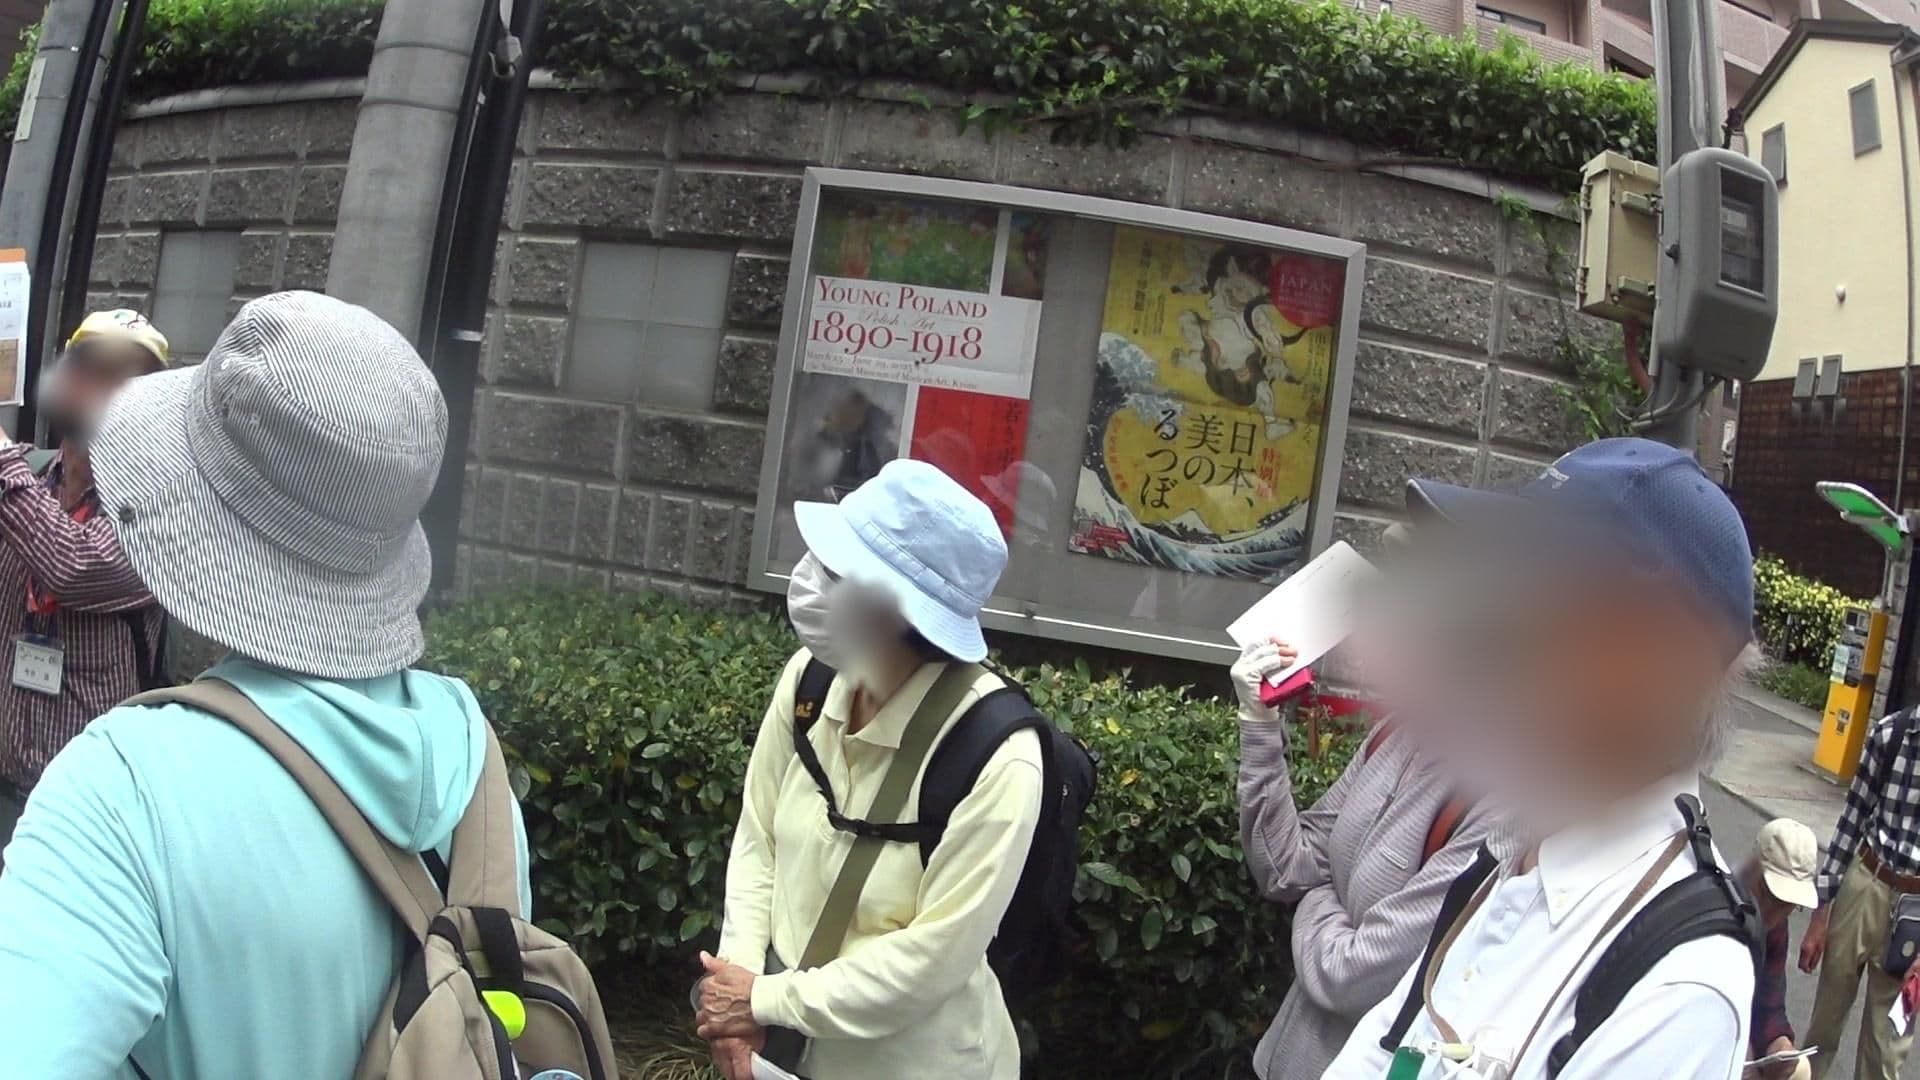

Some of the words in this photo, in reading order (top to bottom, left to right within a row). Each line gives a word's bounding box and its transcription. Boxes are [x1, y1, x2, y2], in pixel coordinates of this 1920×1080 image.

[817, 278, 889, 308] YOUNG
[898, 286, 987, 319] POLAND
[1279, 272, 1332, 295] JAPAN
[808, 311, 982, 365] 1890-1918
[1140, 409, 1178, 510] るつぼ
[1183, 413, 1224, 486] 美の
